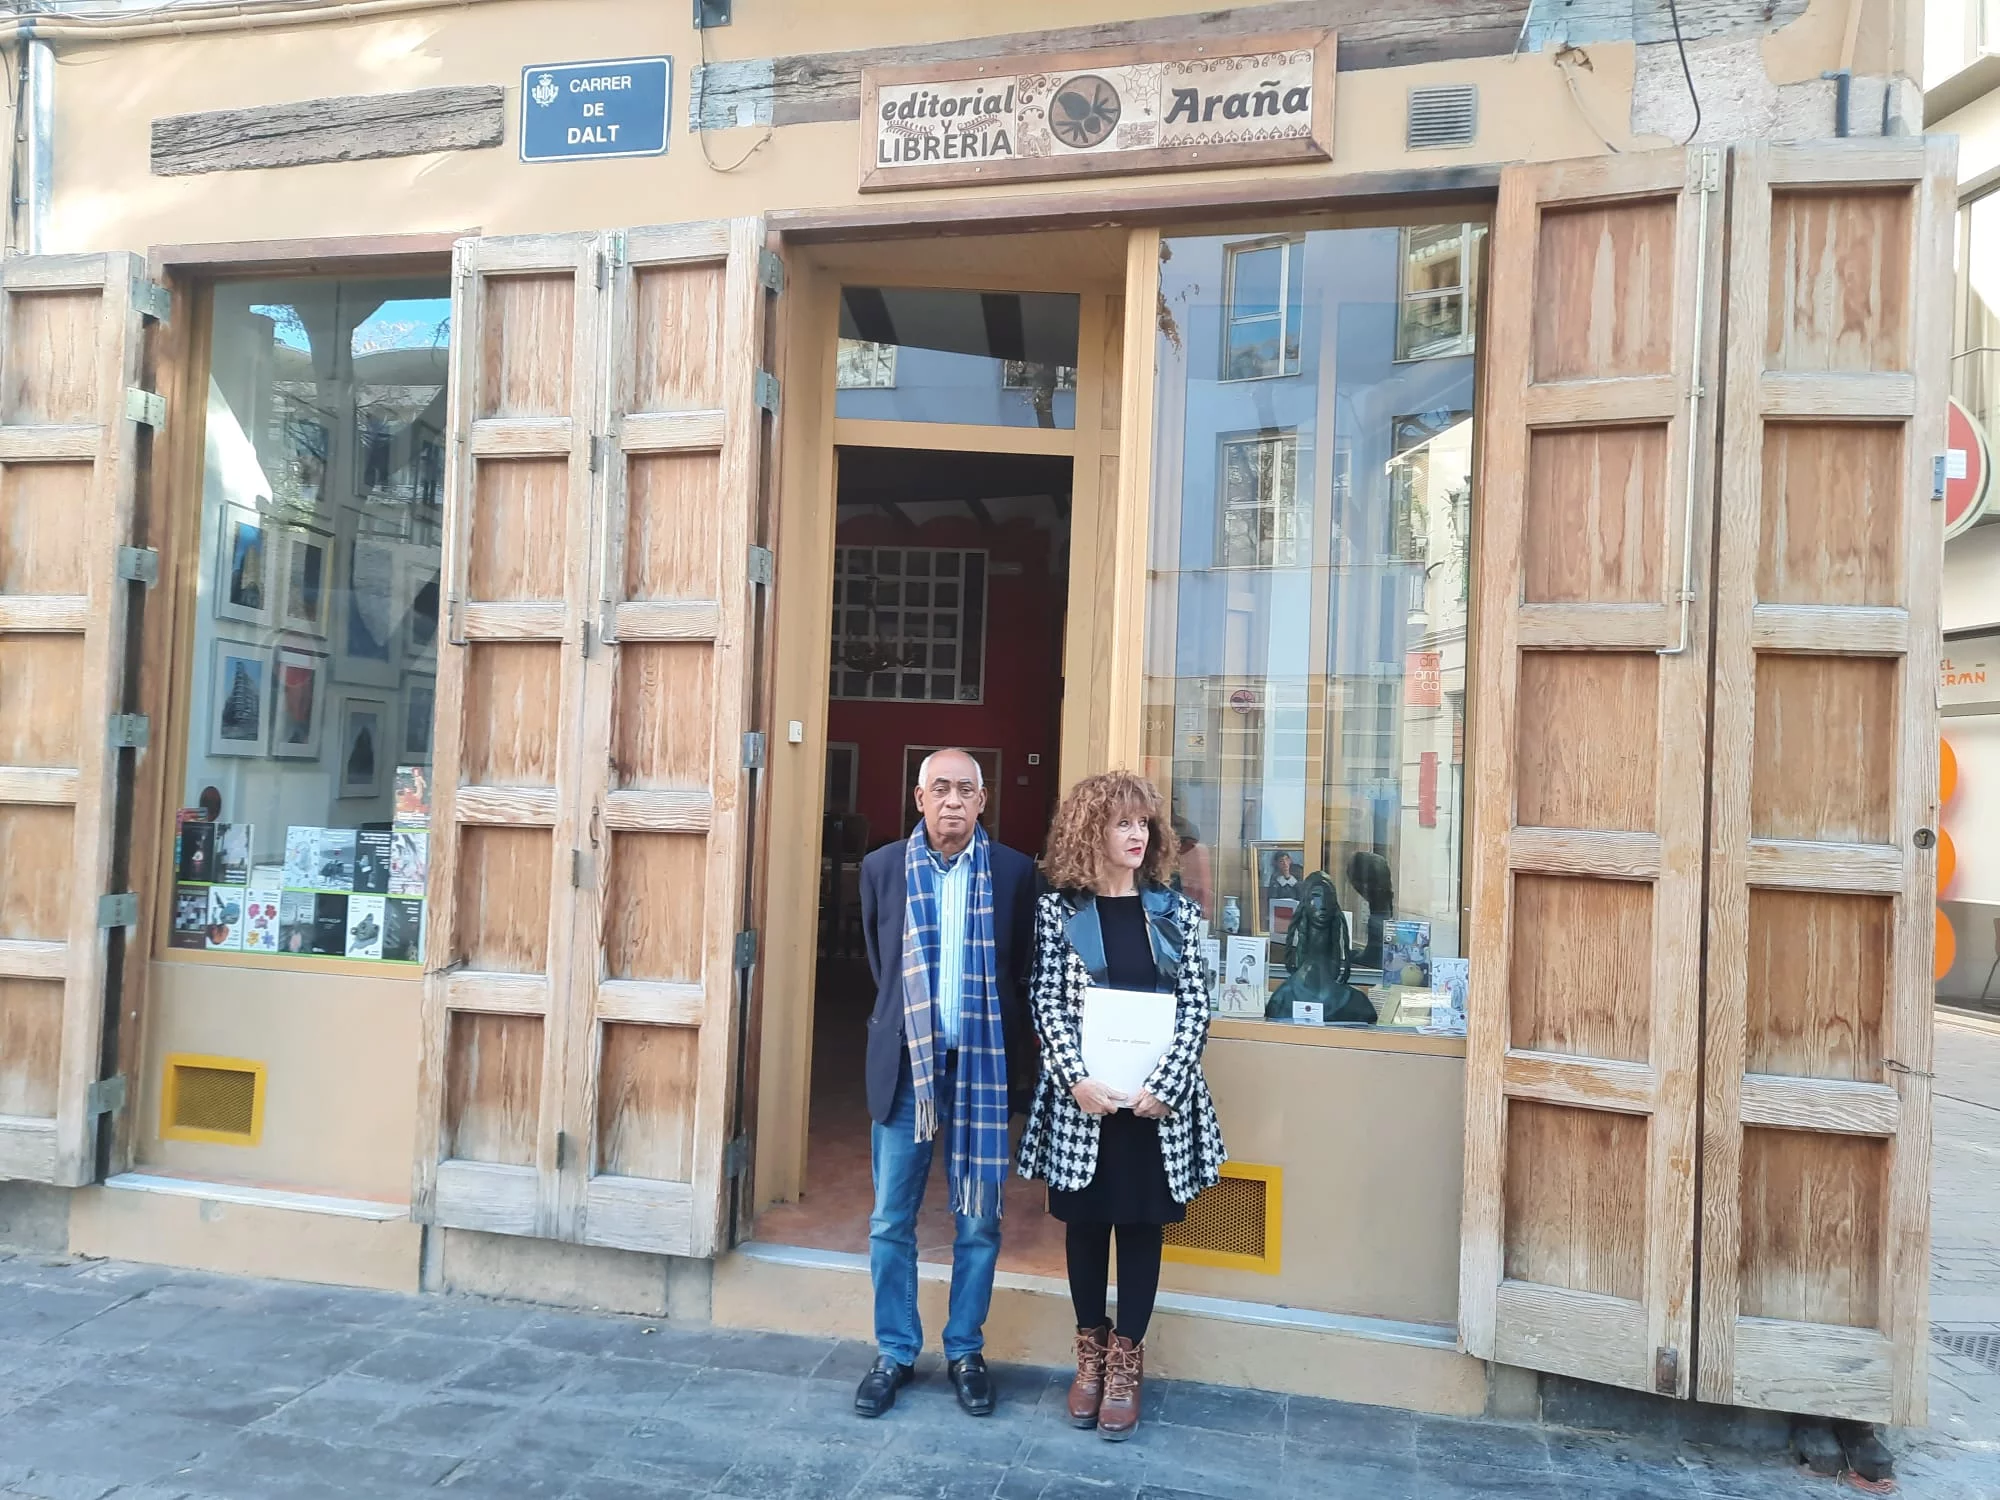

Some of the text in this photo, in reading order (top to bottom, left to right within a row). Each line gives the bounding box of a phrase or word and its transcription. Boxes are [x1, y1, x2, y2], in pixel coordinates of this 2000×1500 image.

[569, 75, 632, 93] CARRER
[583, 102, 605, 117] DE
[881, 84, 1016, 121] editorial
[1163, 80, 1312, 124] Araña
[567, 124, 620, 145] DALT
[941, 119, 953, 134] Y
[878, 129, 1013, 163] LIBRERIA
